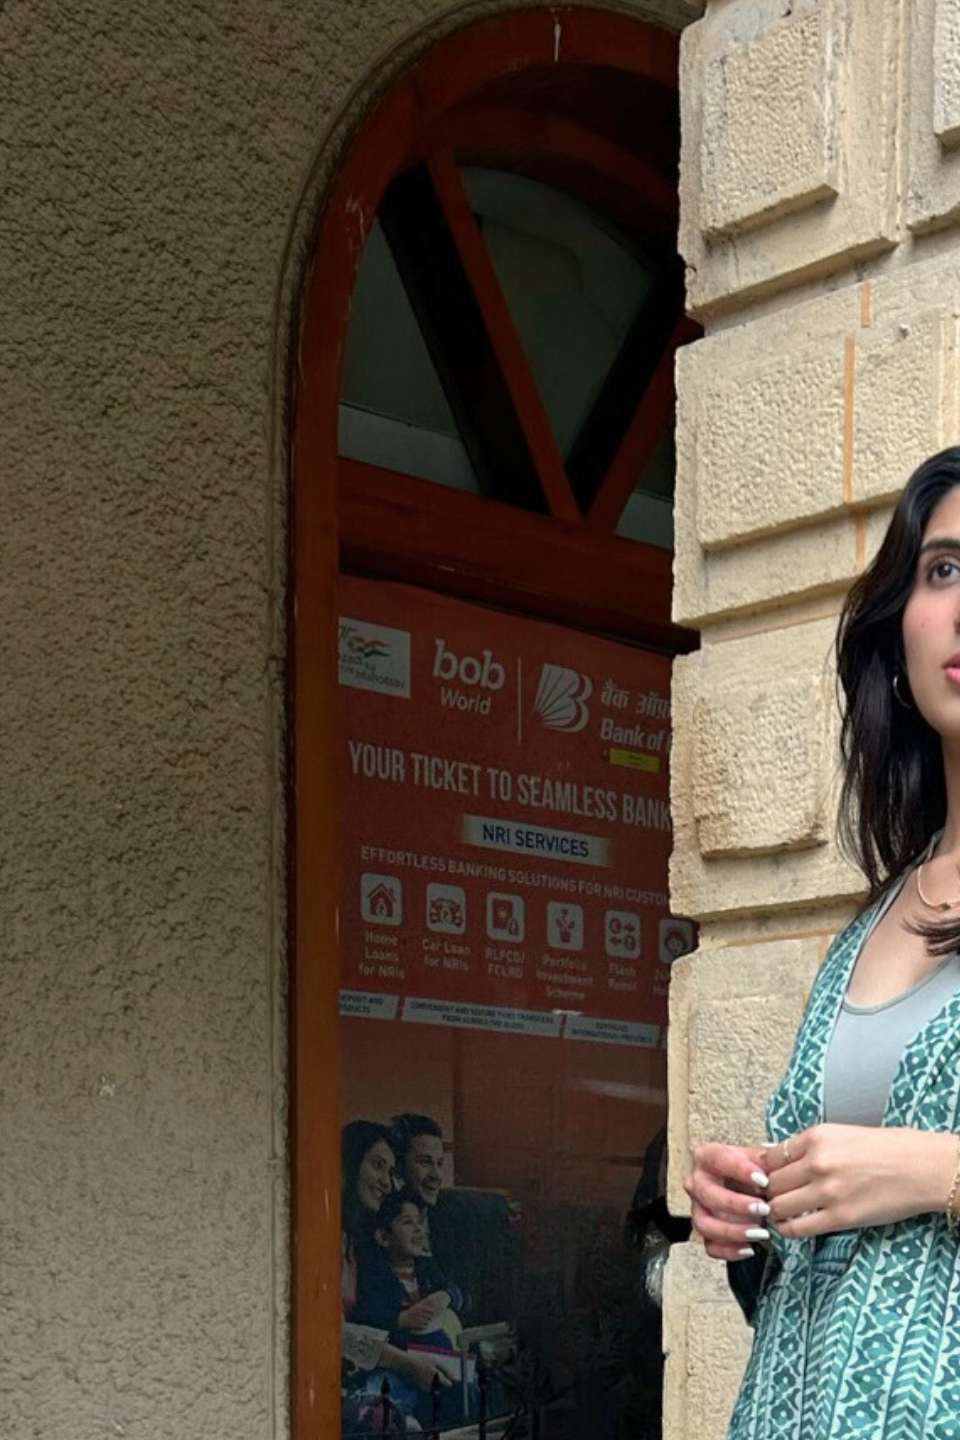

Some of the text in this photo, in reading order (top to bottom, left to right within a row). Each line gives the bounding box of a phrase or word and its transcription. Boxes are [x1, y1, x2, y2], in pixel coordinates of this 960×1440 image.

[432, 639, 506, 691] bob
[440, 686, 492, 715] World
[600, 717, 645, 749] Bank
[647, 729, 666, 752] of
[348, 740, 406, 783] YOUR
[410, 752, 481, 797] TICKET
[486, 767, 512, 802] TO
[517, 773, 618, 822] SEAMLESS
[482, 823, 589, 858] NRI SERVICES
[361, 845, 446, 872] EFFORTLESS
[448, 860, 506, 882] BANKING
[508, 871, 577, 892] SOLUTIONS
[578, 880, 602, 895] FOR
[365, 930, 399, 946] Home
[422, 938, 440, 951] Car
[358, 962, 375, 976] for
[365, 947, 400, 962] Loans
